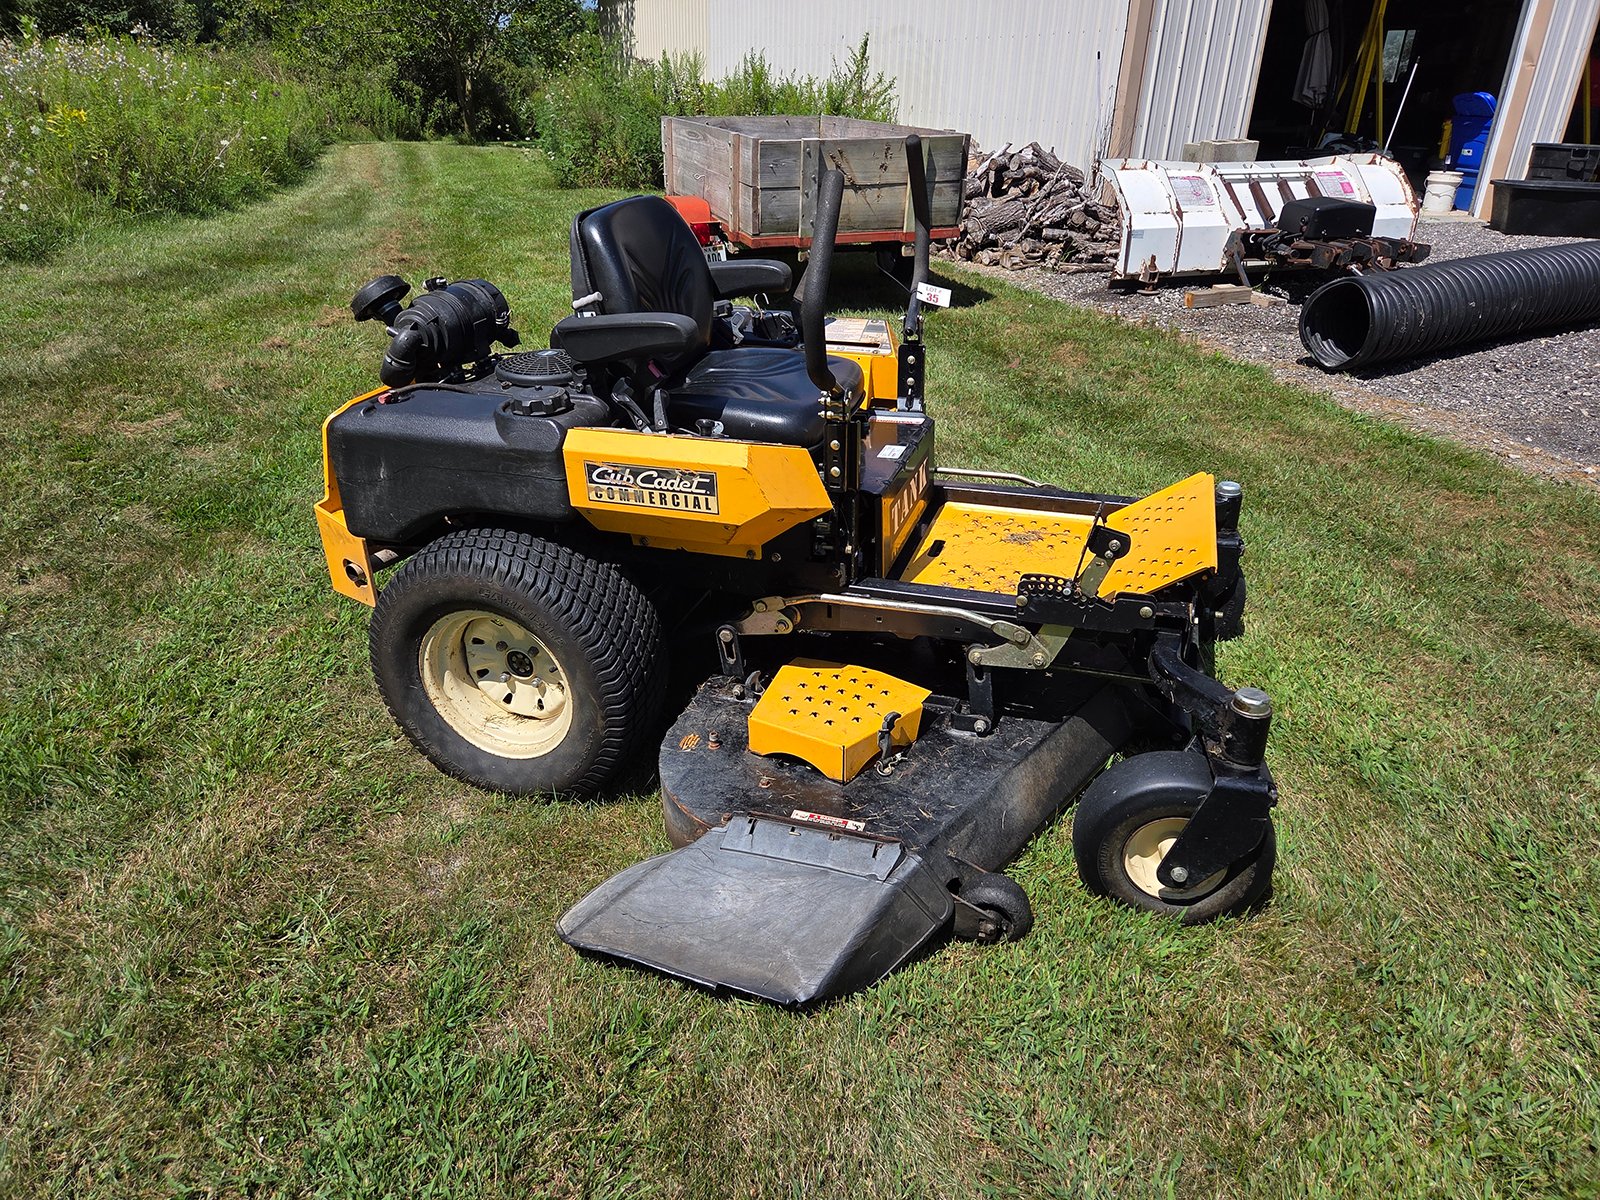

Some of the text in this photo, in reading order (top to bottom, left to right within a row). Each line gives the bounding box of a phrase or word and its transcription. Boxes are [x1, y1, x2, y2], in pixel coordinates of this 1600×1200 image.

[926, 292, 939, 303] 35
[591, 466, 635, 485] Cub
[594, 485, 712, 511] COMMERCIAL
[891, 456, 929, 535] TANK
